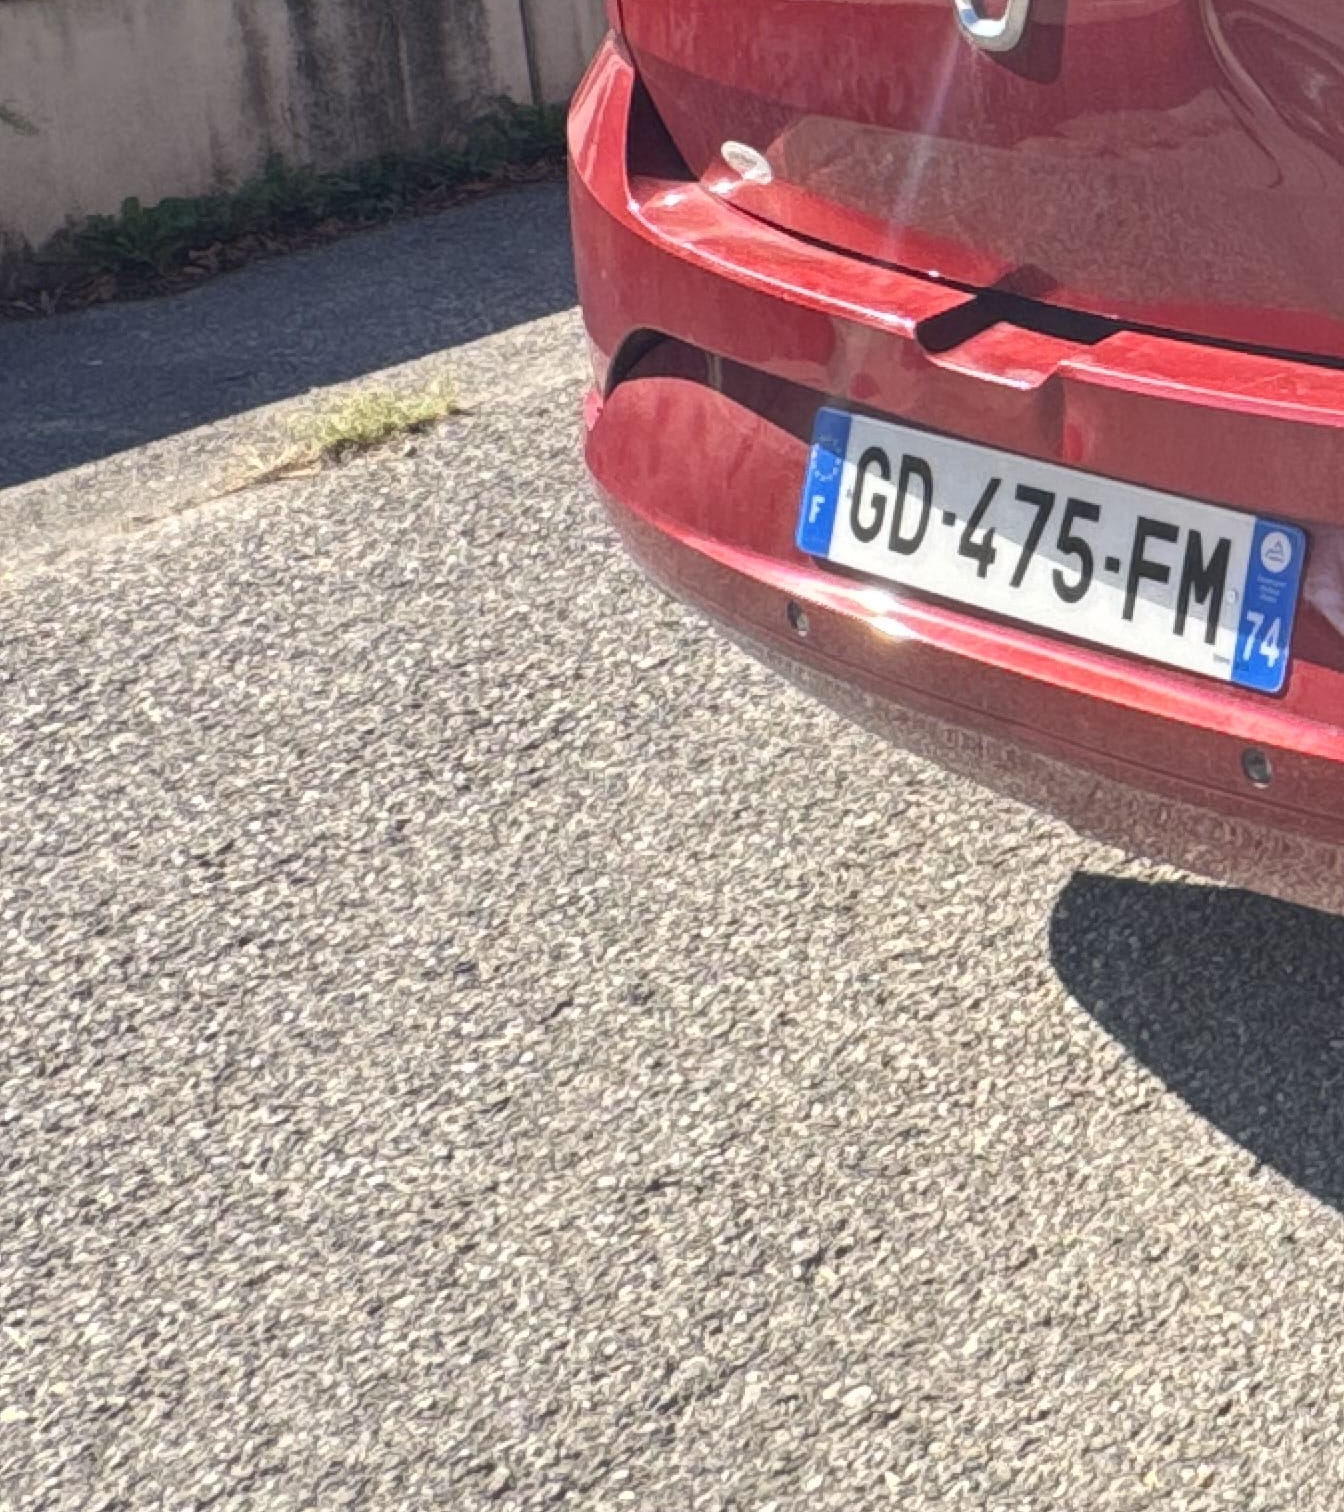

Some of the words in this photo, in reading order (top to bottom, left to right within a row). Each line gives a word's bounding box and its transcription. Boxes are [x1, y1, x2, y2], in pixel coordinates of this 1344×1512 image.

[808, 496, 826, 524] F
[849, 446, 1233, 646] GD-475-FM
[1242, 610, 1282, 669] 74
